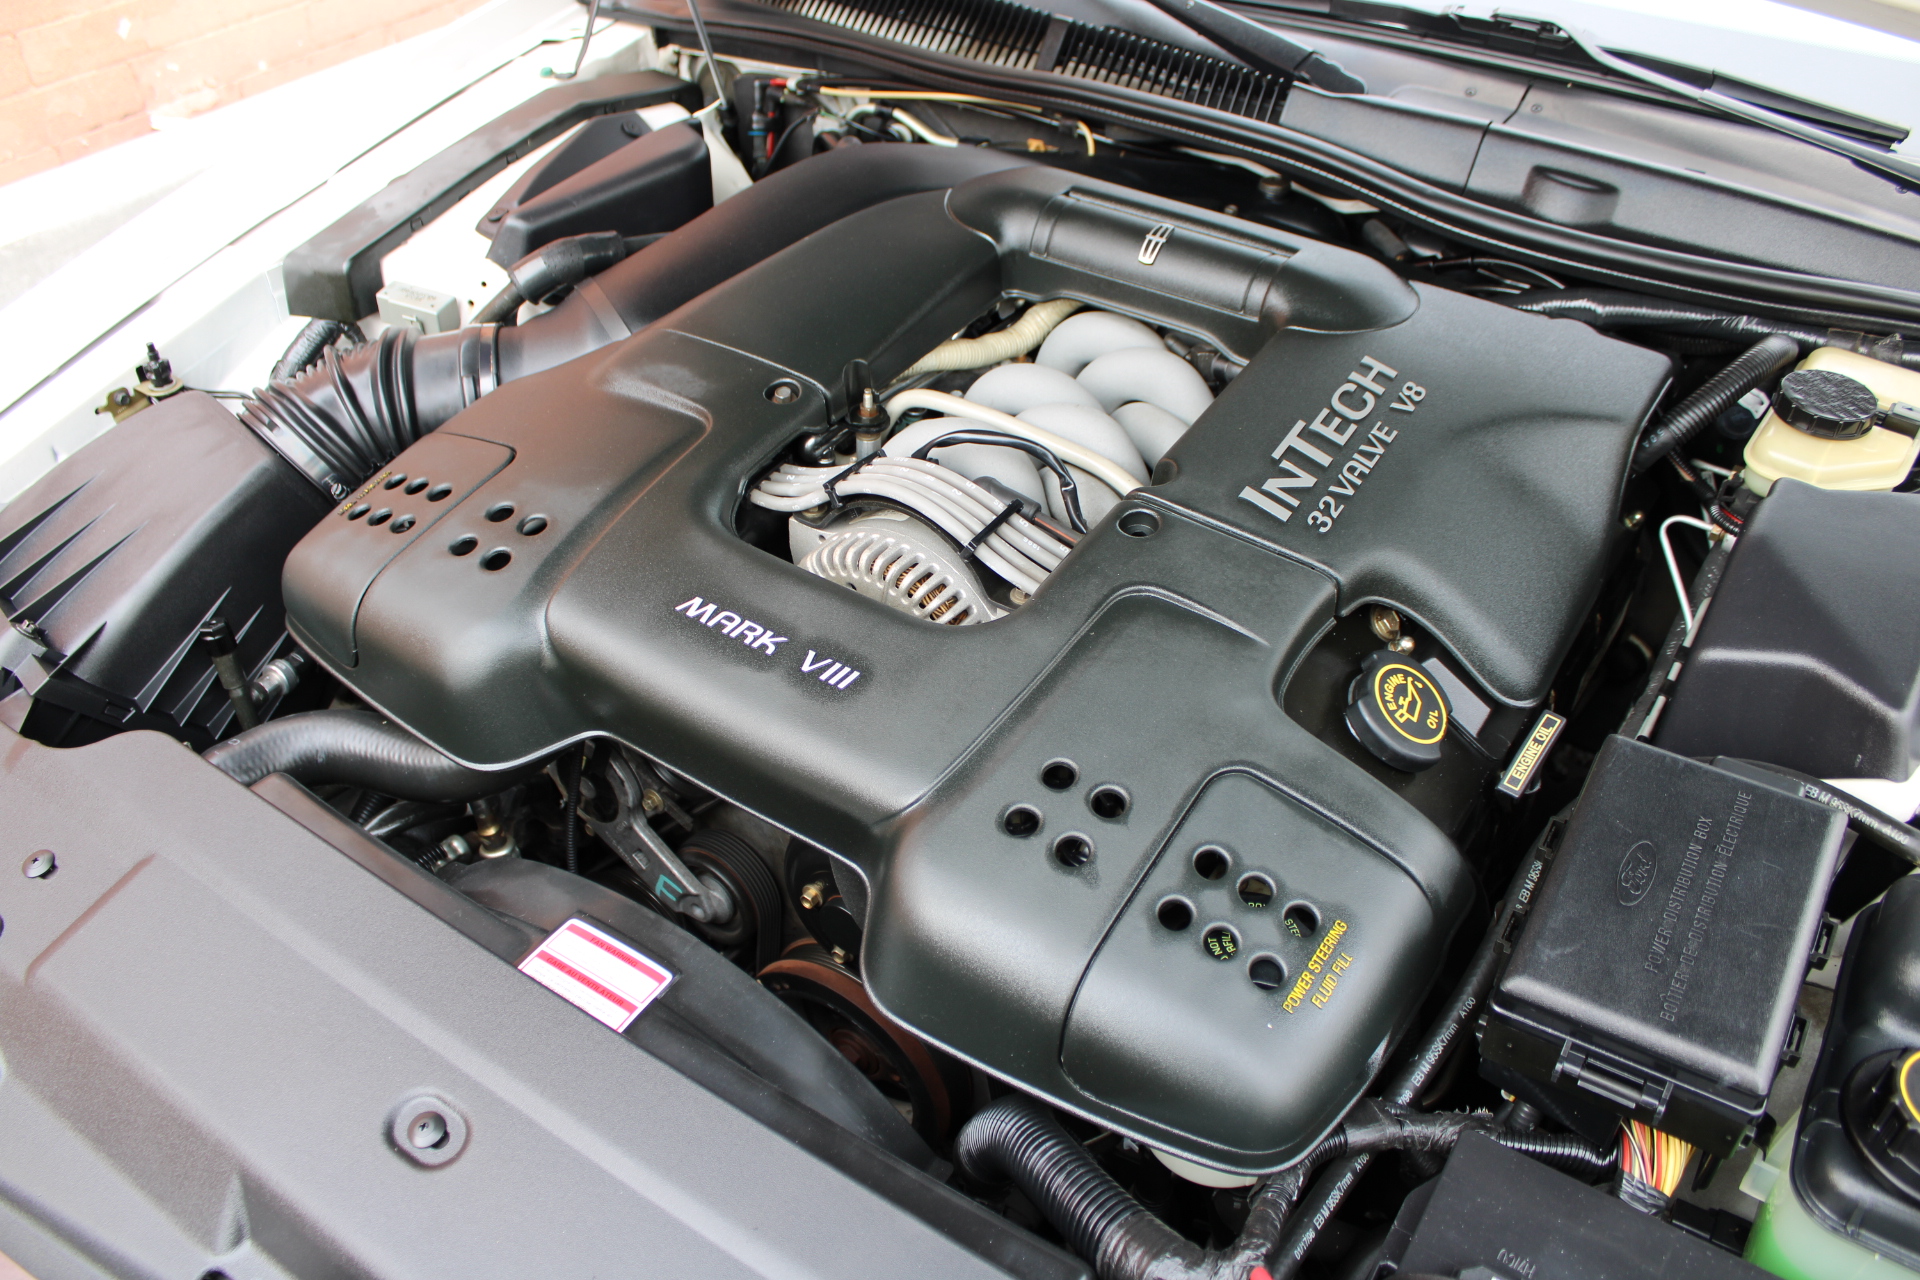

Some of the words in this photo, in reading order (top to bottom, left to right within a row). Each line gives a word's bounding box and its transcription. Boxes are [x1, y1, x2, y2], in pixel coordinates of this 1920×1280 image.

[1307, 495, 1344, 533] 32
[1328, 421, 1398, 496] VALVE
[1390, 381, 1427, 414] V8
[675, 596, 789, 655] MARK
[800, 649, 861, 690] VIII
[1383, 673, 1407, 711] ENGINE
[1426, 709, 1439, 730] OIL
[1511, 740, 1542, 780] ENGINE
[1535, 726, 1553, 742] OIL
[1644, 927, 1673, 974] POWER
[1664, 842, 1703, 922] DISTRIBUTION
[1693, 815, 1713, 840] BOX
[1688, 860, 1728, 942] DISTRIBUTION
[546, 957, 566, 971] GARE
[590, 937, 605, 949] FAN
[604, 944, 638, 967] WARNING
[1281, 971, 1315, 1014] POWER
[1307, 920, 1348, 973] STEERING
[1680, 947, 1698, 966] DE
[1311, 973, 1338, 1009] FLUID
[1332, 952, 1354, 977] FILL
[1458, 996, 1476, 1019] A100
